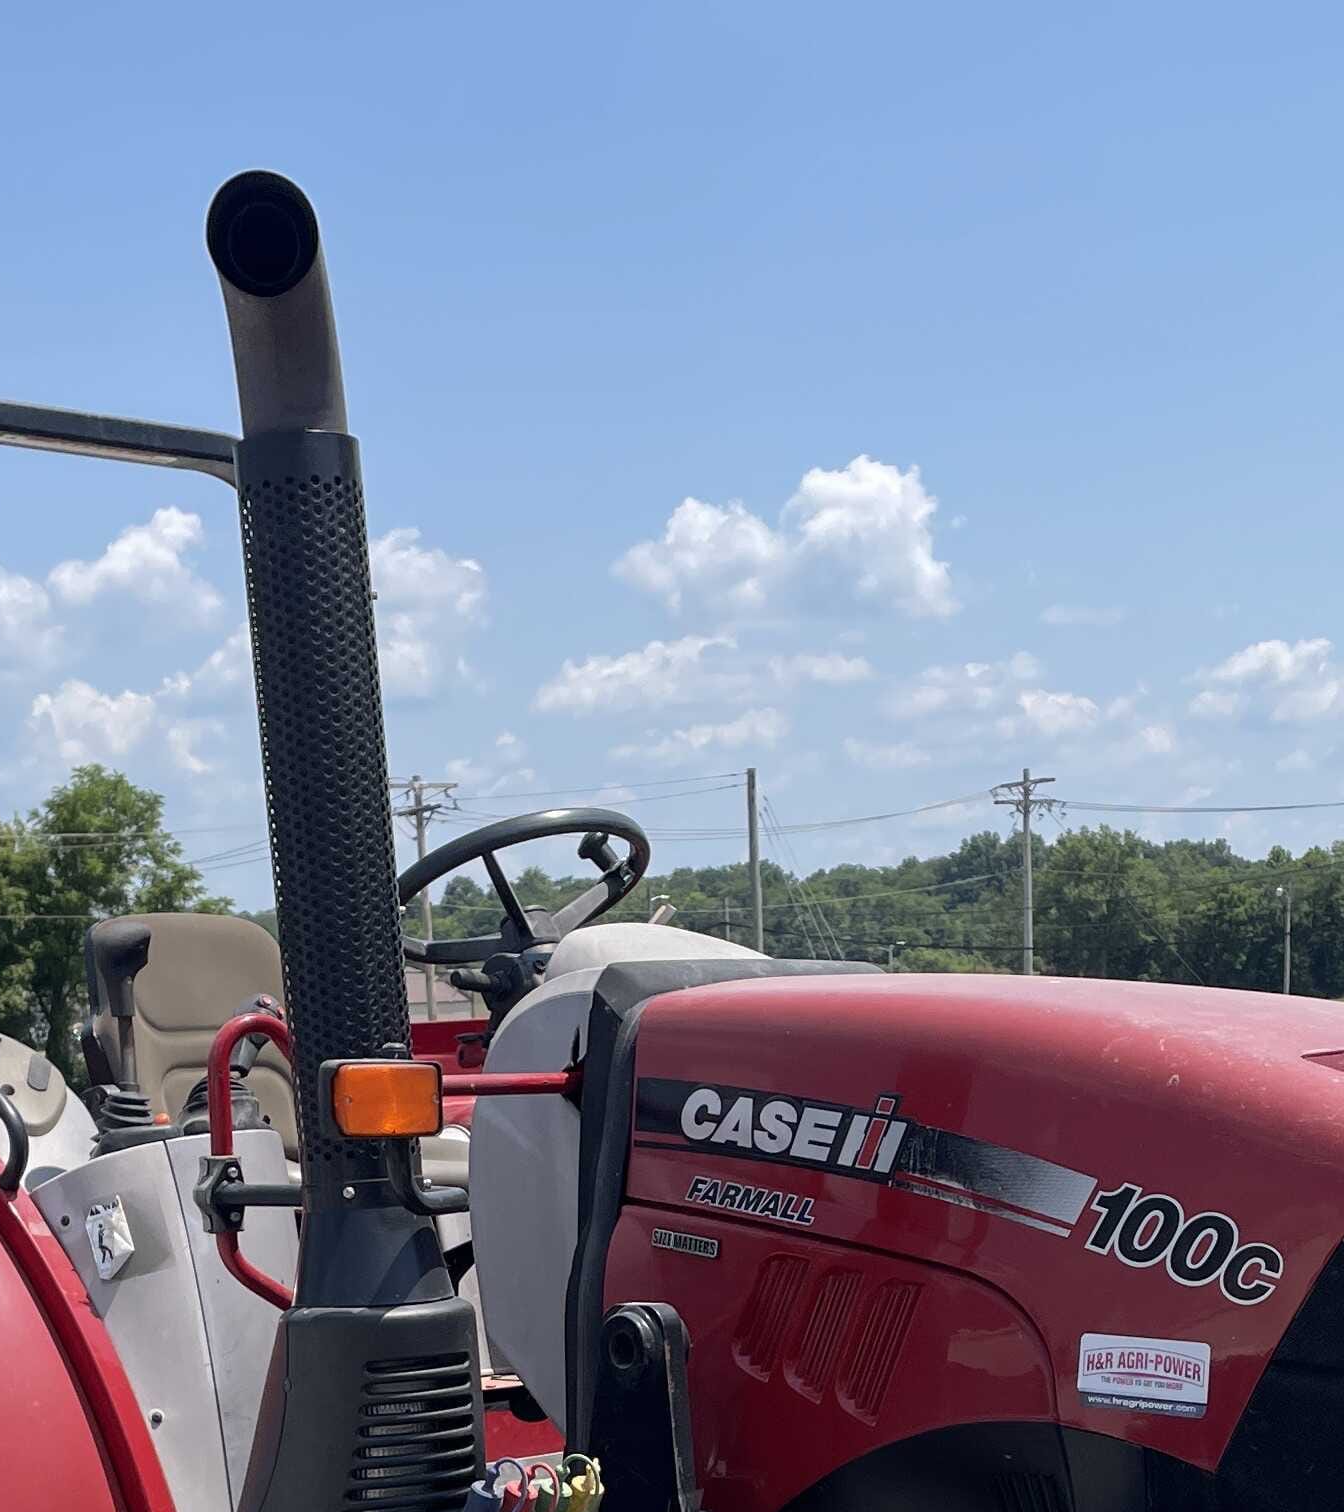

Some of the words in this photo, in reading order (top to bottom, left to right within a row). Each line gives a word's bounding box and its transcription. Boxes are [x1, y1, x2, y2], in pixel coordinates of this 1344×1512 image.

[680, 1088, 843, 1162] CASE
[685, 1176, 815, 1226] FARMALL
[653, 1229, 673, 1248] SIZE
[673, 1233, 717, 1257] MATTERS
[1084, 1182, 1285, 1306] 100C
[1086, 1351, 1114, 1372] H&R
[1117, 1351, 1202, 1382] AGRI-POWER
[1087, 1395, 1197, 1414] www.hragripower.com
